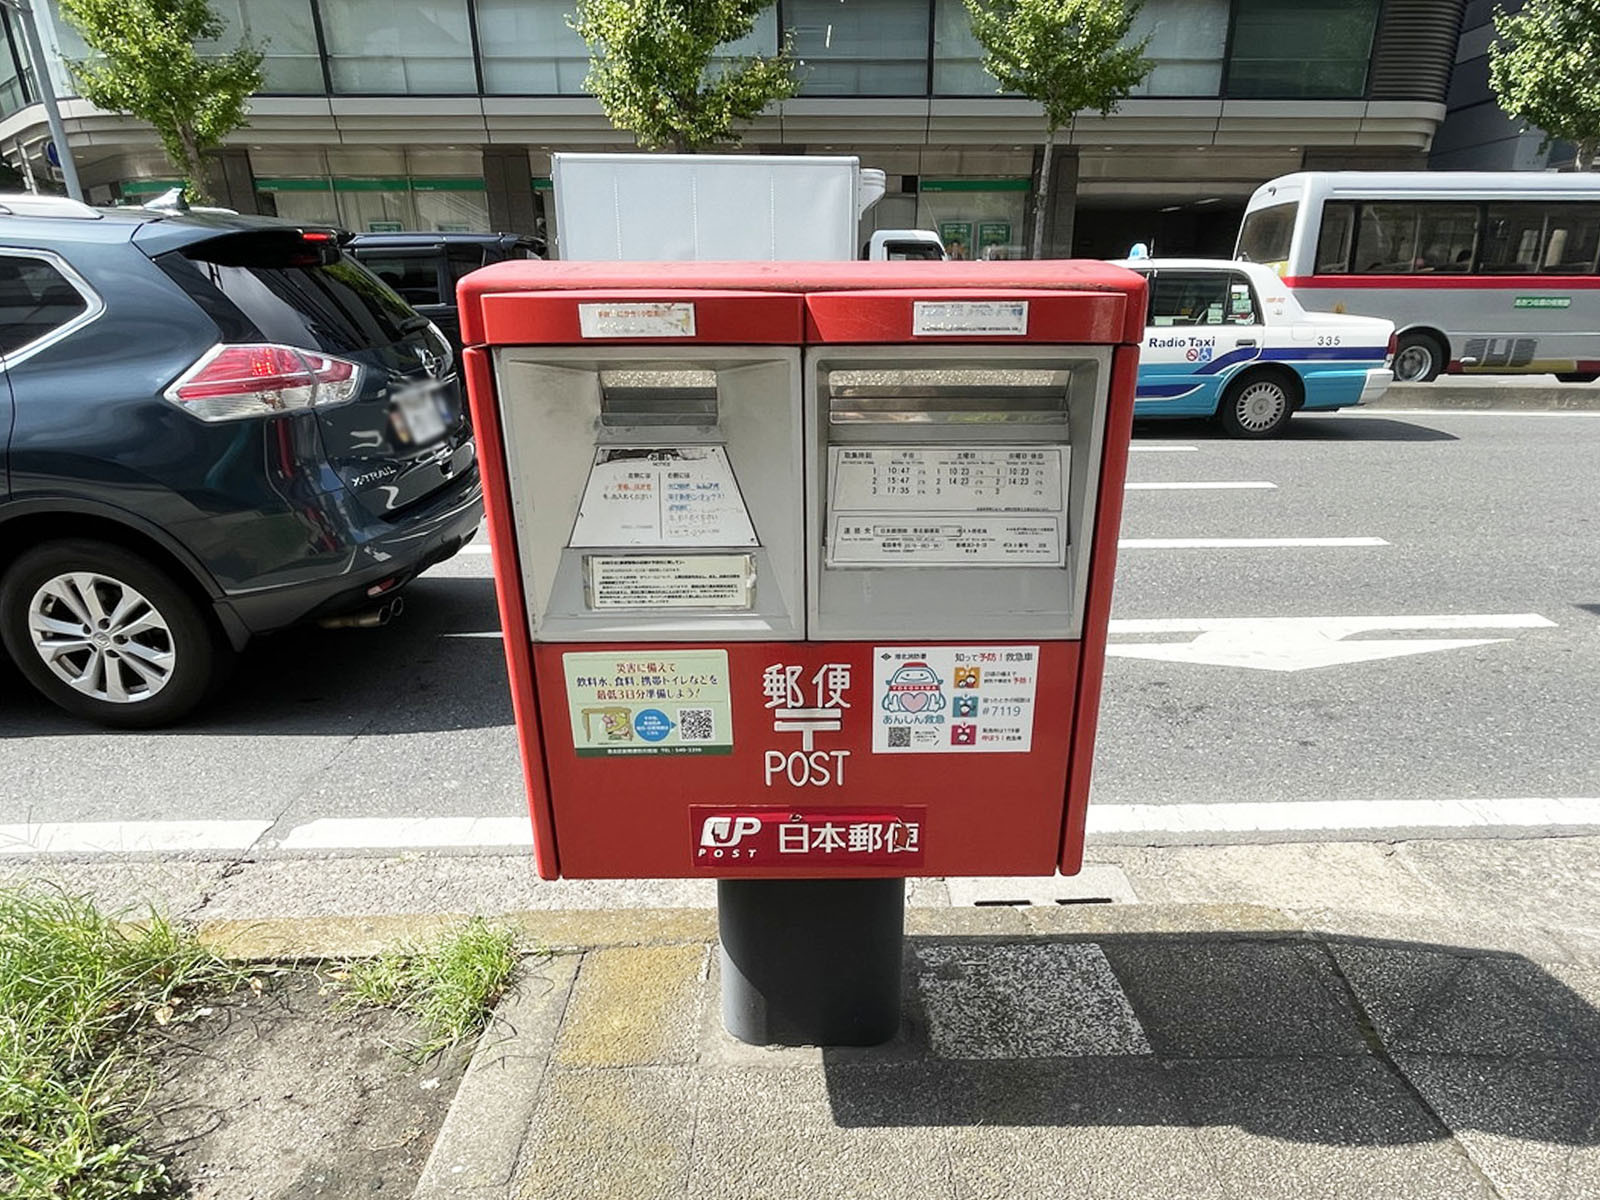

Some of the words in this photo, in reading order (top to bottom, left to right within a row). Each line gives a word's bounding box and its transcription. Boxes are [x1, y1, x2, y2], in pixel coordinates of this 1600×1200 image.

[1149, 337, 1186, 348] Radio
[1188, 336, 1216, 347] Taxi
[1317, 336, 1341, 346] 335
[351, 466, 397, 487] X-TRAIL
[949, 467, 970, 476] 10:23
[1009, 467, 1029, 476] 10:23
[949, 477, 969, 485] 14:23
[1008, 477, 1029, 485] 14:23
[616, 662, 677, 673] 災害に備えて
[576, 674, 719, 688] 飲料水、食料、携帯トイレなどを
[763, 663, 852, 709] 郵便
[982, 705, 1022, 717] #7119
[882, 714, 946, 725] あんしん救急
[765, 750, 851, 786] POST
[701, 816, 762, 846] JP
[698, 849, 757, 858] POST
